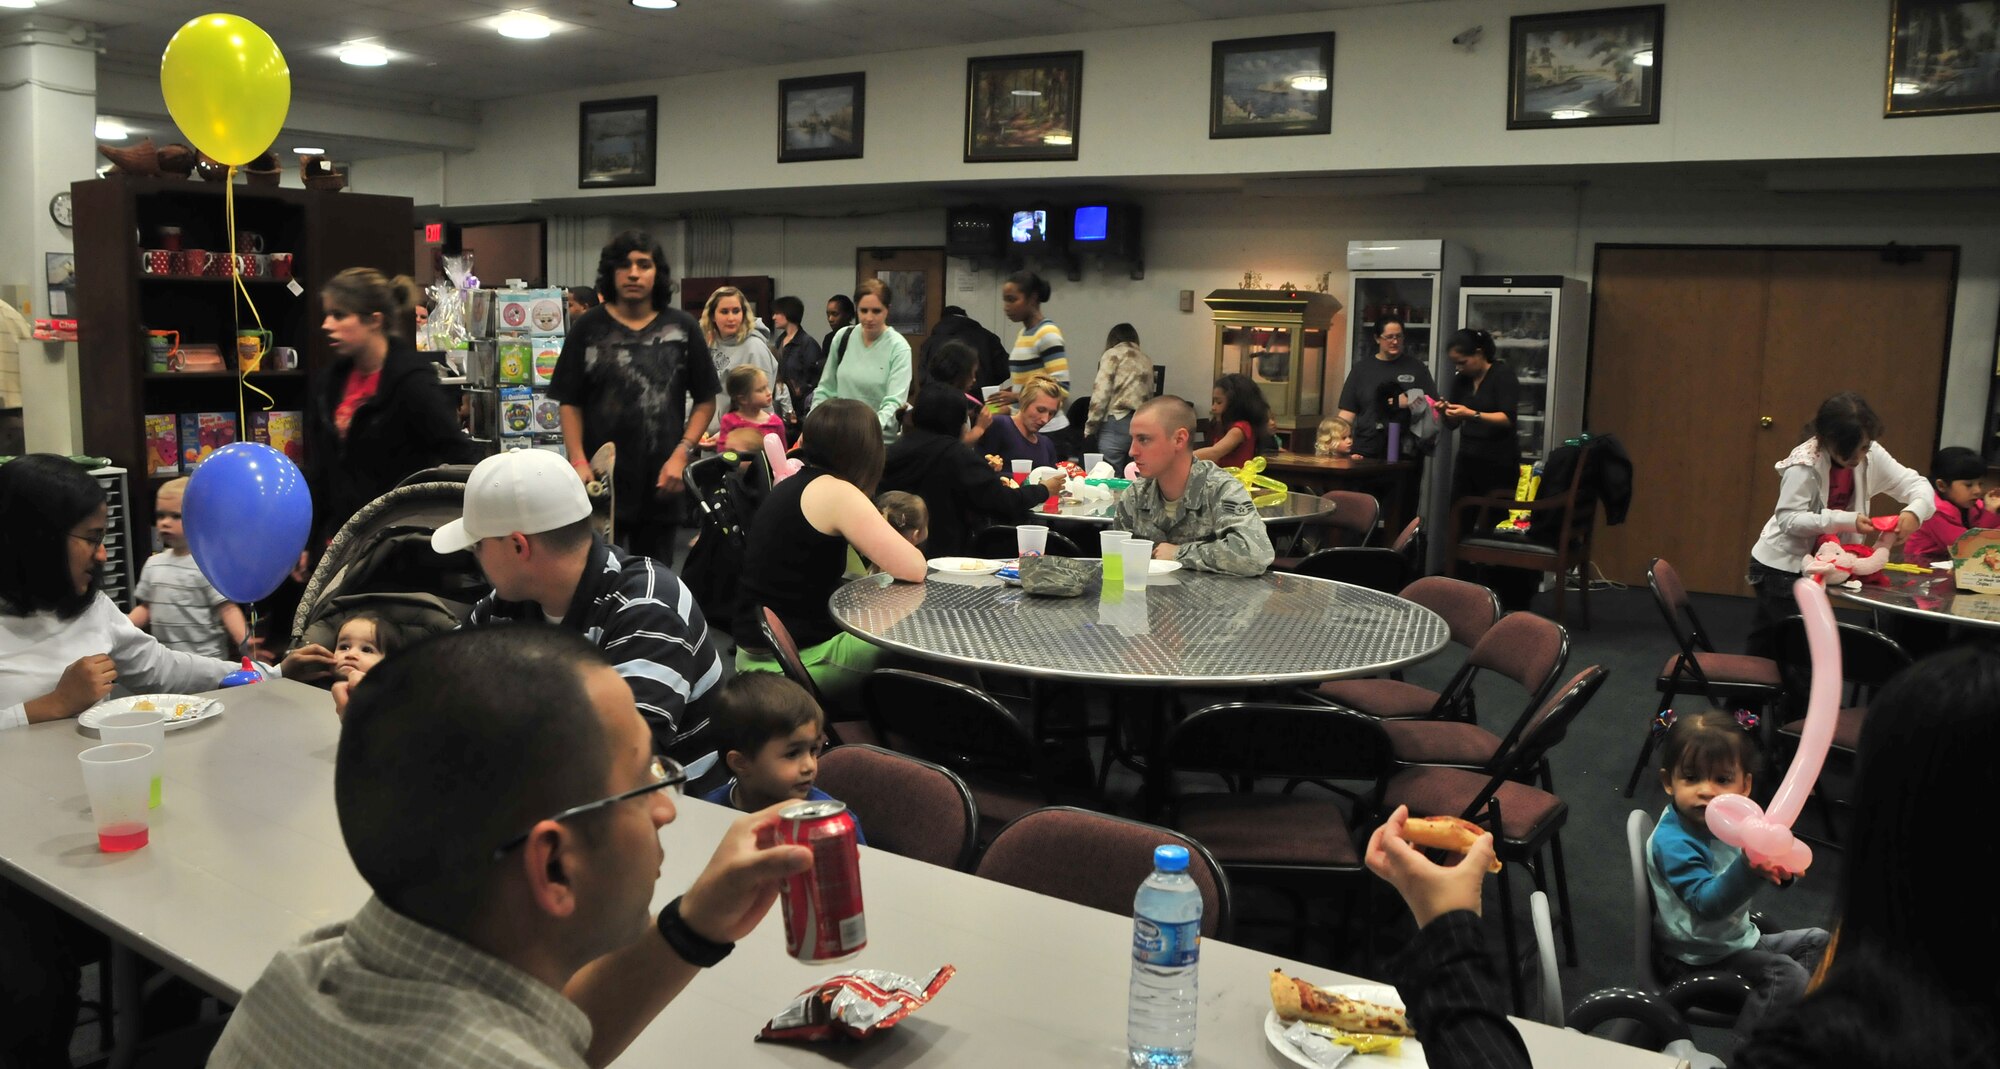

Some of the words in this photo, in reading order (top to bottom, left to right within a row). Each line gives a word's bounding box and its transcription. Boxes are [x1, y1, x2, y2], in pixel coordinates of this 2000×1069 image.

[426, 224, 441, 242] EXIT
[146, 418, 162, 426] Sew
[155, 424, 174, 432] Bear
